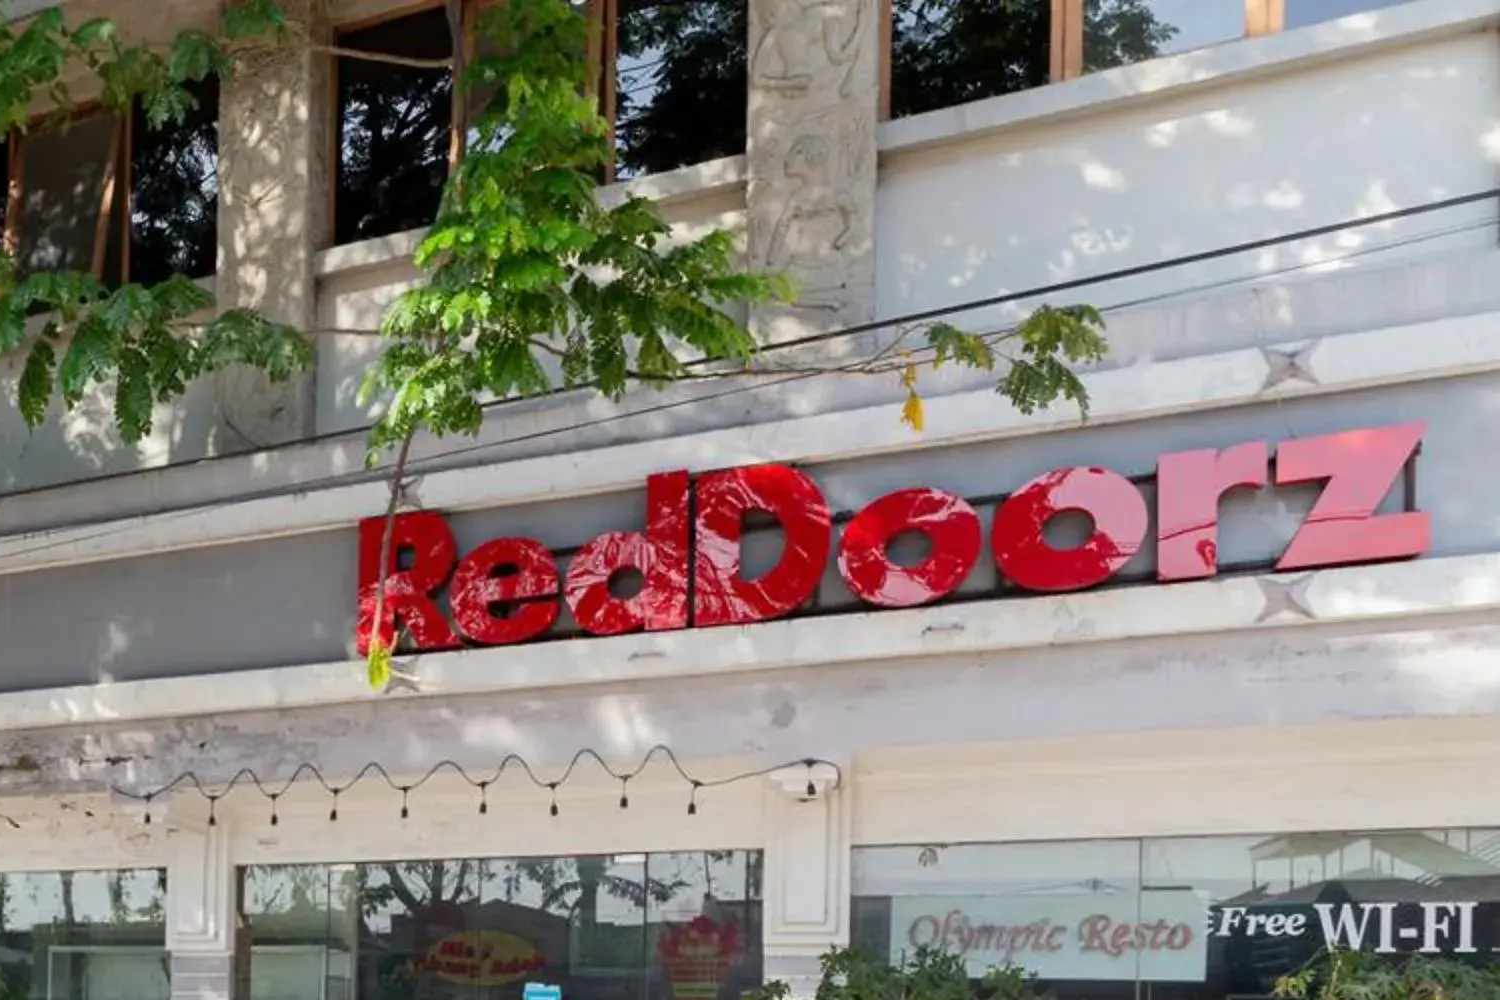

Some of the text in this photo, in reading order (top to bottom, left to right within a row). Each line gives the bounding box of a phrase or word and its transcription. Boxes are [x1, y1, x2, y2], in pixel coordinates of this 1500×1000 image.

[357, 419, 1432, 657] RedDoorz
[908, 909, 1194, 963] Olympic Resto
[1215, 906, 1306, 936] Free
[1313, 901, 1478, 953] WI-FI
